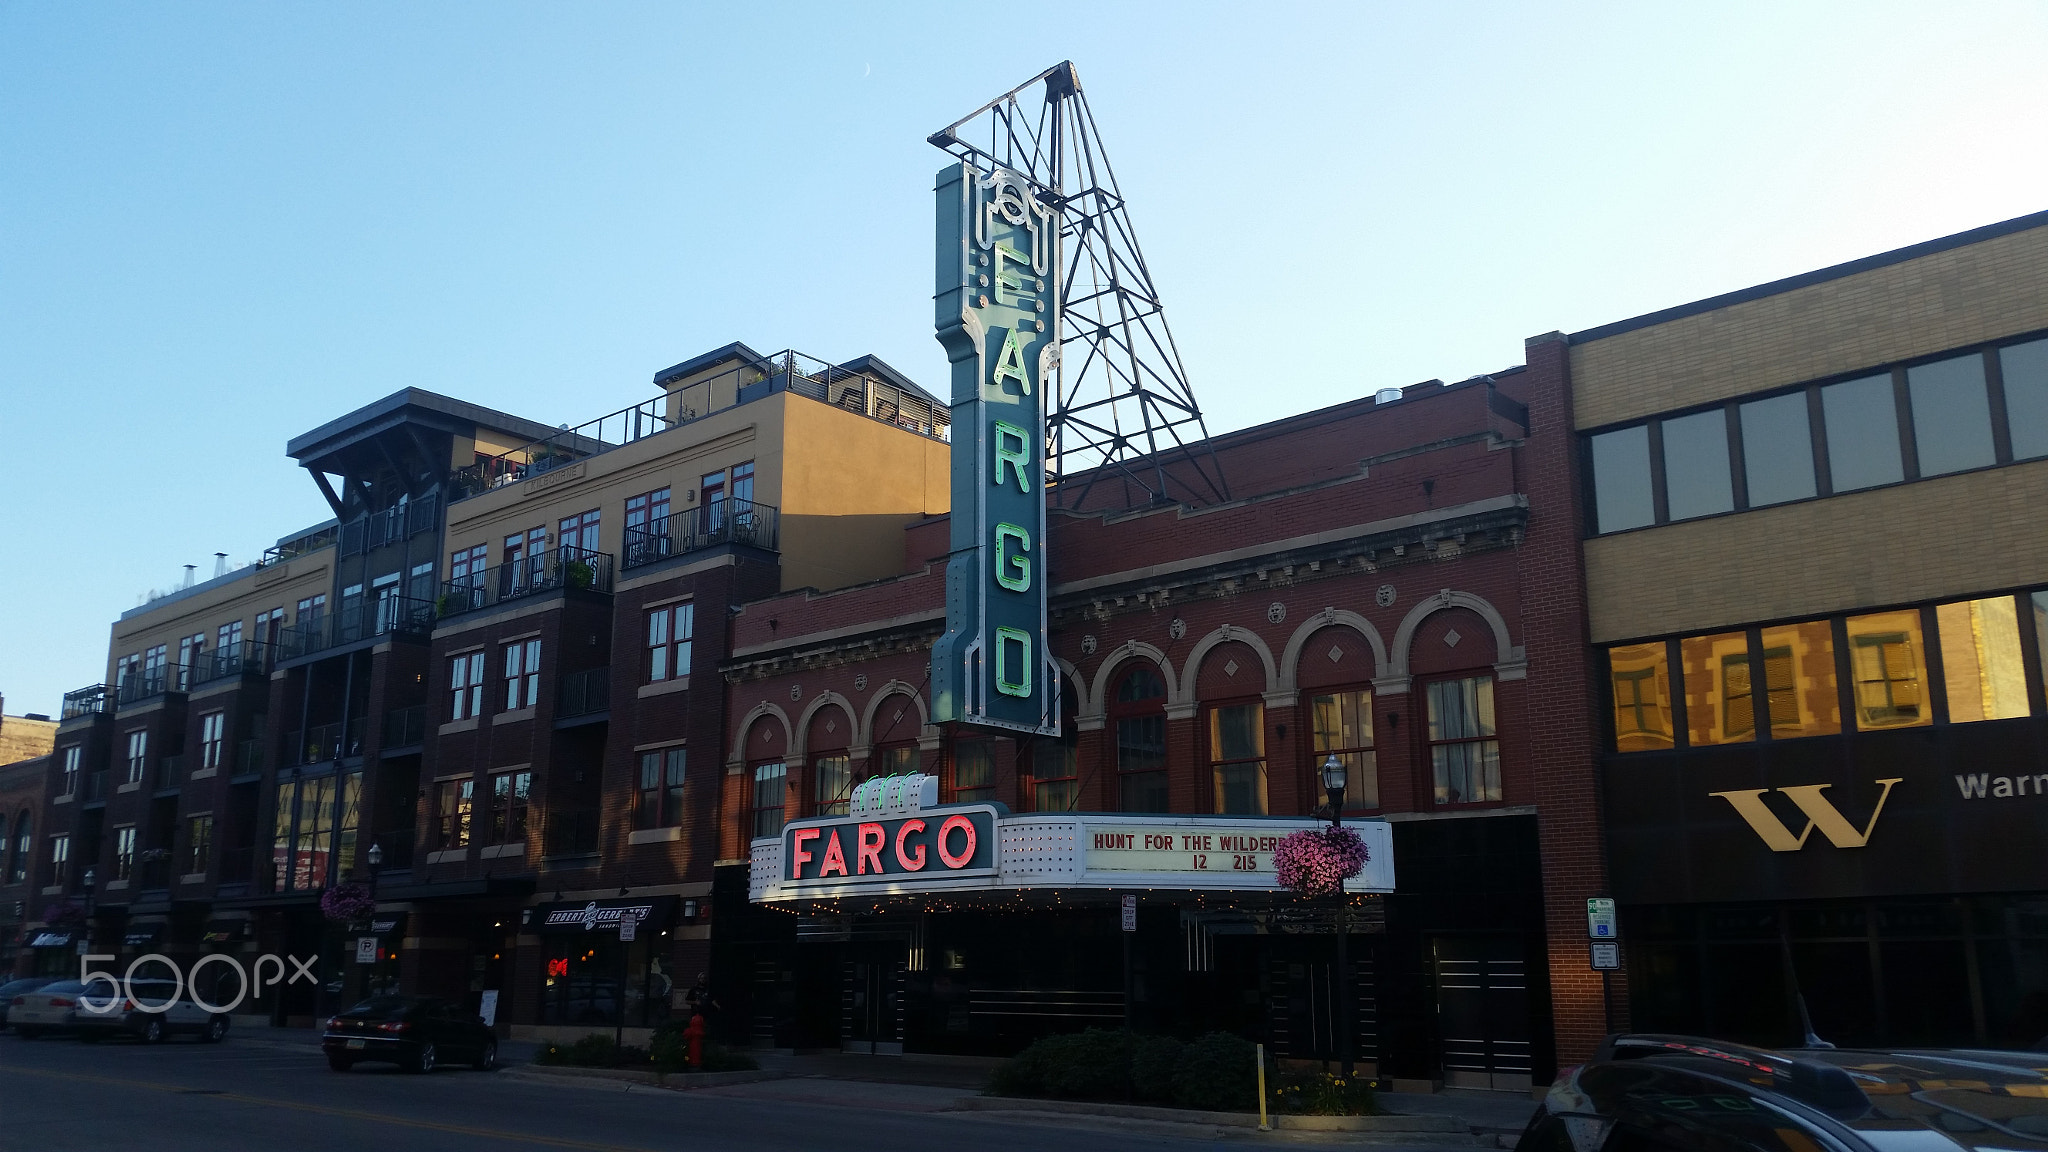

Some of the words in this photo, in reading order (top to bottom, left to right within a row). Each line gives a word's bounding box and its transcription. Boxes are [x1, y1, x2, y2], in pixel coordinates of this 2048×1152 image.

[993, 241, 1033, 699] FARGO
[1954, 773, 2048, 799] Warn
[1708, 777, 1903, 852] W
[793, 814, 977, 879] FARGO
[1094, 834, 1135, 849] HUNT
[1145, 835, 1173, 850] FOR
[1182, 836, 1212, 850] THE
[1193, 854, 1208, 869] 12
[1233, 855, 1257, 870] 215
[549, 912, 585, 922] ERBERT
[597, 908, 648, 920] GERBT'S
